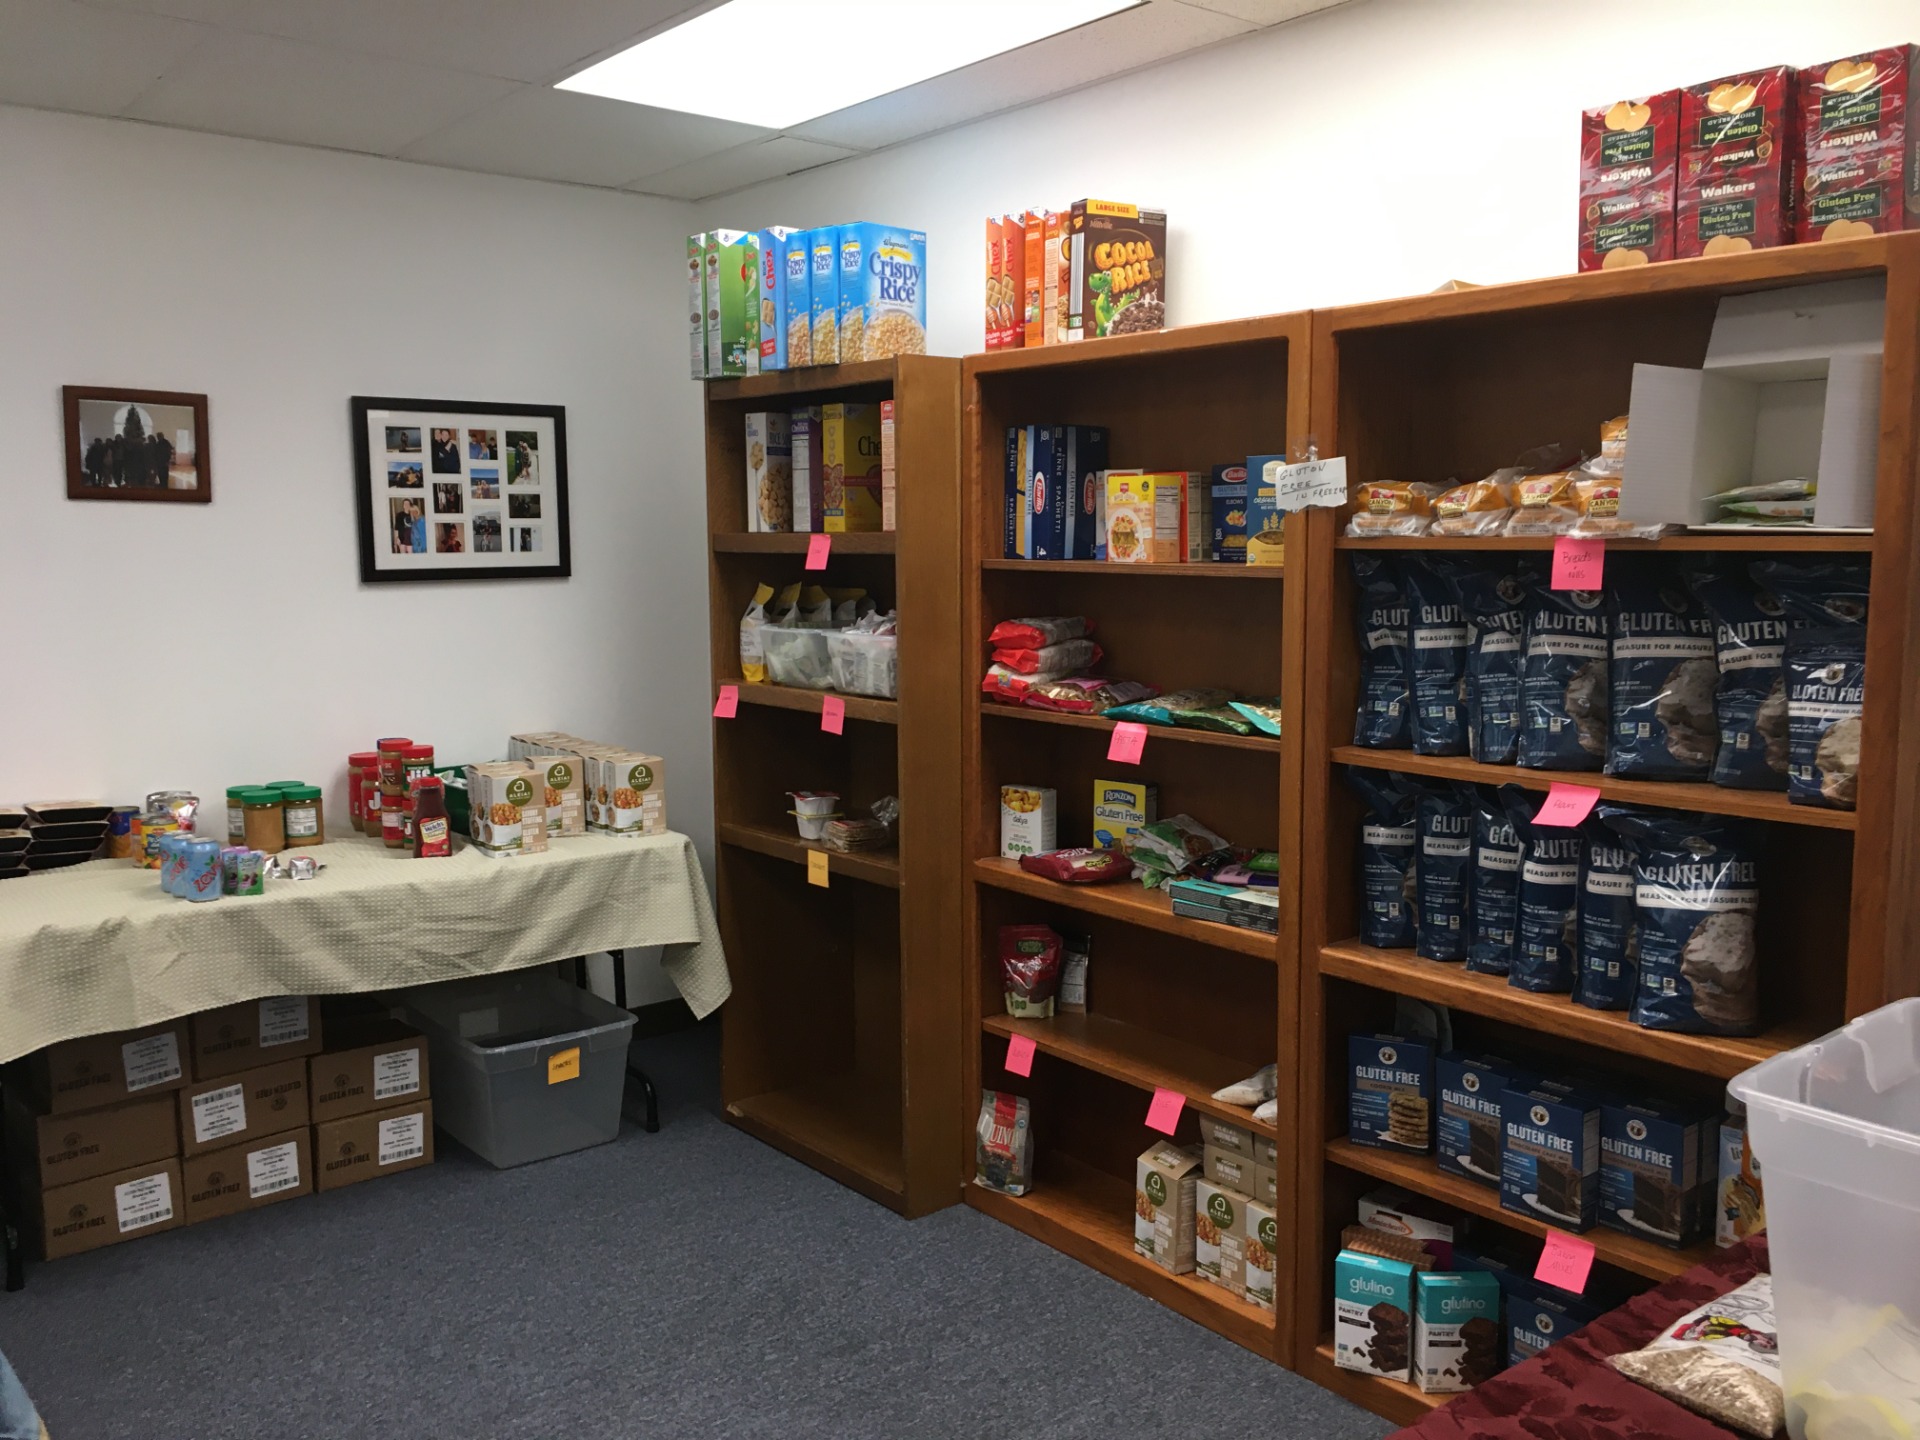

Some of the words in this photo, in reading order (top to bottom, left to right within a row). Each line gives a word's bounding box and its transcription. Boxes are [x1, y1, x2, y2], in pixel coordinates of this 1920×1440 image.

[1728, 123, 1759, 134] Gluten
[1624, 141, 1650, 152] Gluten
[1820, 130, 1878, 149] Walkers
[1713, 150, 1754, 162] Walkers
[1600, 166, 1652, 183] Walkers
[1820, 169, 1865, 183] Walkers
[1701, 181, 1756, 199] Walkers
[1601, 201, 1640, 215] Walkers
[1818, 195, 1851, 208] Gluten
[1853, 192, 1876, 202] Free
[1095, 203, 1115, 212] LARGE
[1116, 206, 1130, 214] SIZE
[1702, 213, 1730, 225] Gluten
[1732, 211, 1751, 221] Free
[1599, 226, 1628, 238] Gluten
[1630, 223, 1650, 234] Free
[1005, 238, 1014, 273] Chex
[1094, 240, 1155, 271] COCOA
[765, 248, 776, 290] Chex
[869, 251, 921, 288] Crispy
[1110, 260, 1151, 294] RICE
[879, 276, 915, 304] Rice
[1296, 492, 1308, 501] IN
[1590, 499, 1619, 507] CANYON
[1419, 634, 1452, 642] MEASURE
[1616, 643, 1651, 651] MEASURE
[406, 769, 431, 783] Jif
[1105, 790, 1135, 803] RONZONI
[1095, 806, 1124, 819] Gluten
[1125, 811, 1143, 823] Free
[1367, 831, 1398, 839] MEASURE
[1526, 868, 1559, 878] MEASURE
[1646, 863, 1714, 885] GLUTEN
[1356, 1065, 1393, 1081] GLUTEN
[1395, 1071, 1421, 1085] FREE
[1442, 1088, 1476, 1110] GLUTEN
[1478, 1099, 1501, 1118] FREE
[1507, 1122, 1545, 1146] GLUTEN
[1547, 1134, 1573, 1153] FREE
[1601, 1136, 1643, 1160] GLUTEN
[1645, 1149, 1673, 1169] FREE
[1350, 1276, 1394, 1296] glutino
[1338, 1307, 1364, 1317] PANTRY
[1441, 1296, 1486, 1315] glutino
